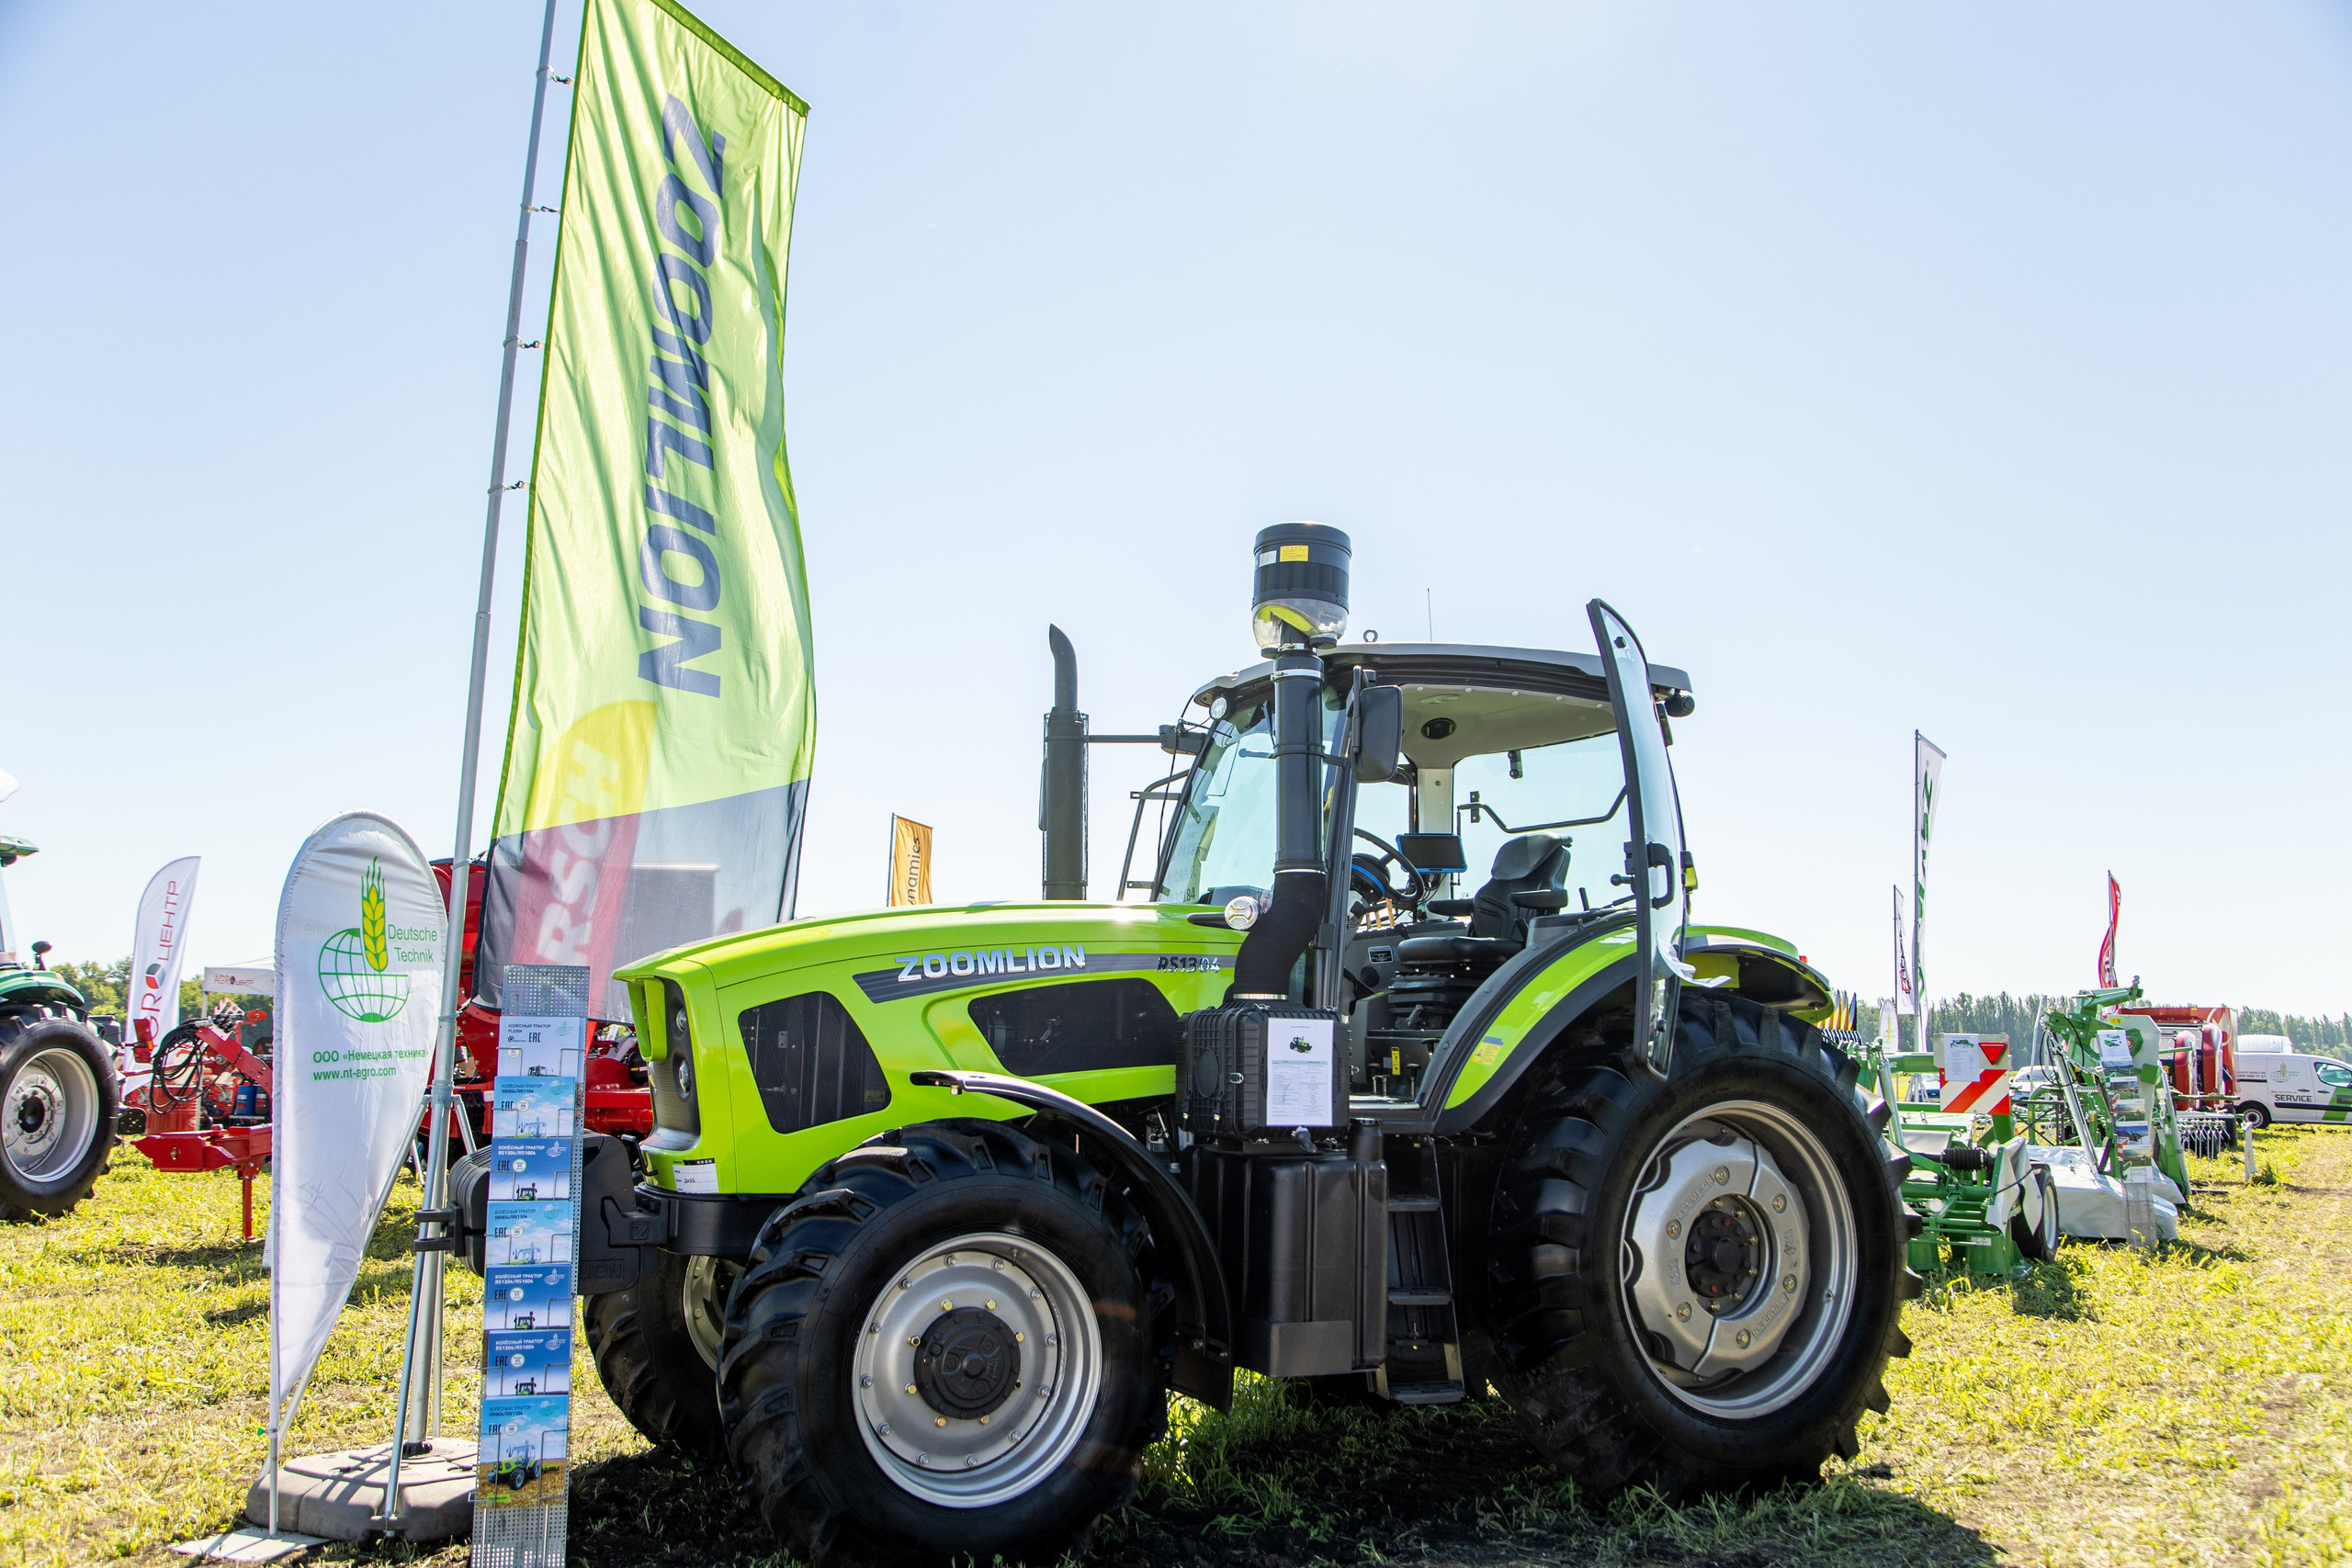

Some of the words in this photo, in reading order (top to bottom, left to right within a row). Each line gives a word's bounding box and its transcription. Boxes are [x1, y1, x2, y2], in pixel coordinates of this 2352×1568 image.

[639, 93, 727, 698] ZOOMLION
[537, 739, 620, 965] RSCH
[388, 924, 437, 942] Deutsche
[394, 947, 435, 963] Technik
[895, 944, 1086, 983] ZOOMLION
[1156, 955, 1221, 974] RS1304
[343, 1049, 392, 1061] «Немецкая
[312, 1066, 396, 1081] www.nt-agro.com
[2274, 1094, 2312, 1102] SERVICE
